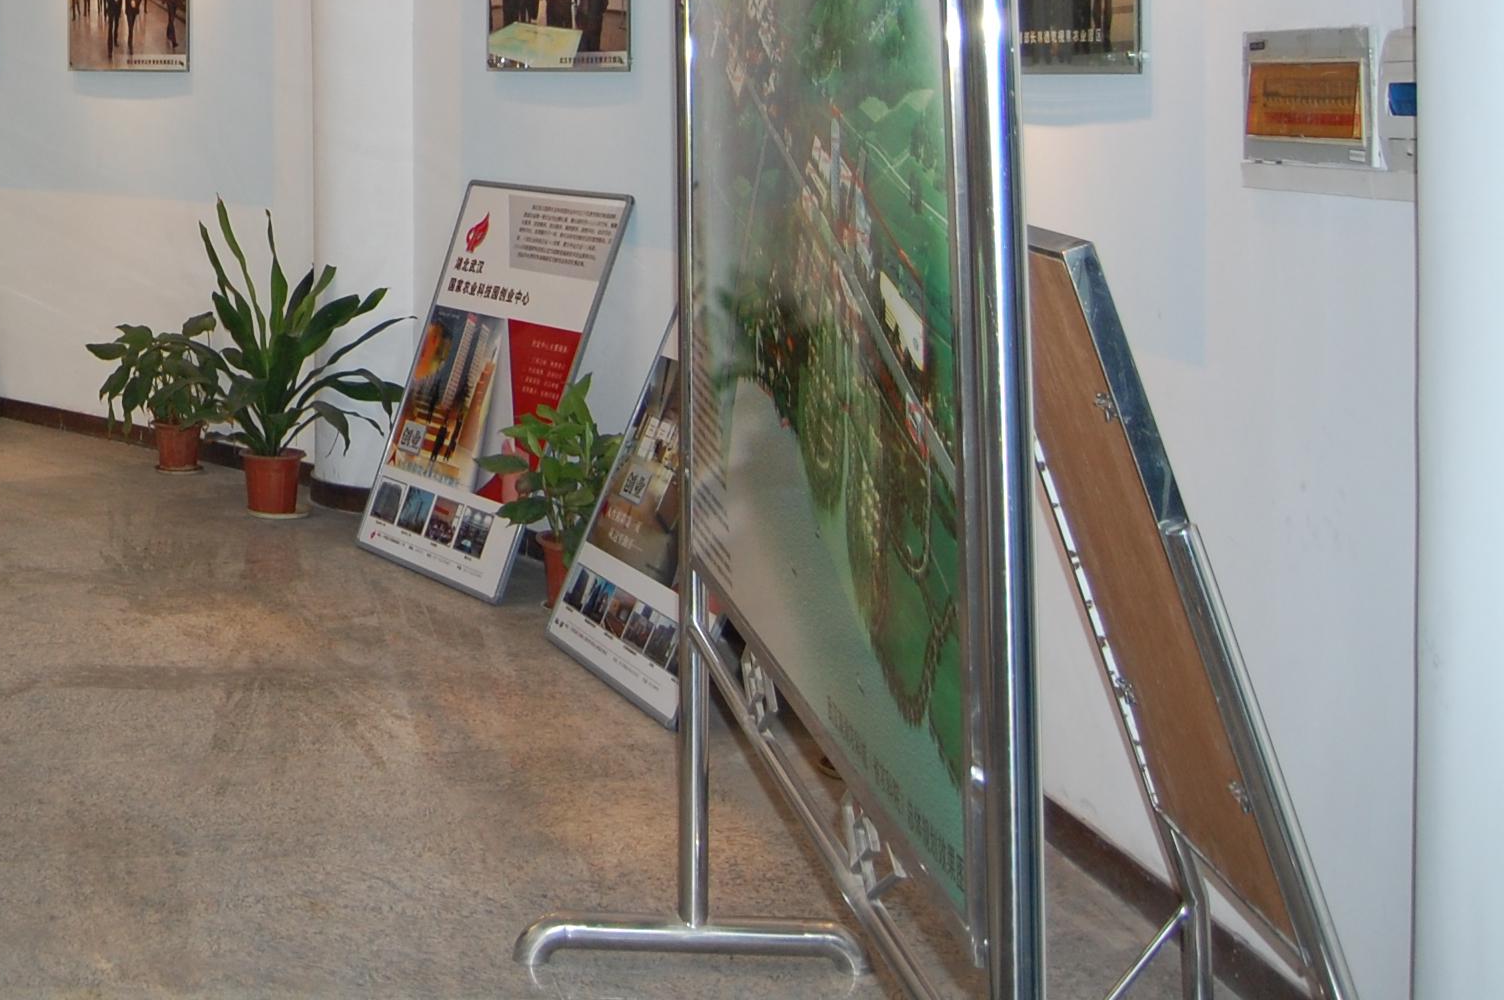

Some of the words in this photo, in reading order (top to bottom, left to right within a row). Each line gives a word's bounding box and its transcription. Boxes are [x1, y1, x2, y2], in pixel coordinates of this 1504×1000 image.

[454, 255, 486, 275] 湖北武汉
[447, 276, 531, 307] 国家农业科技园创业中心
